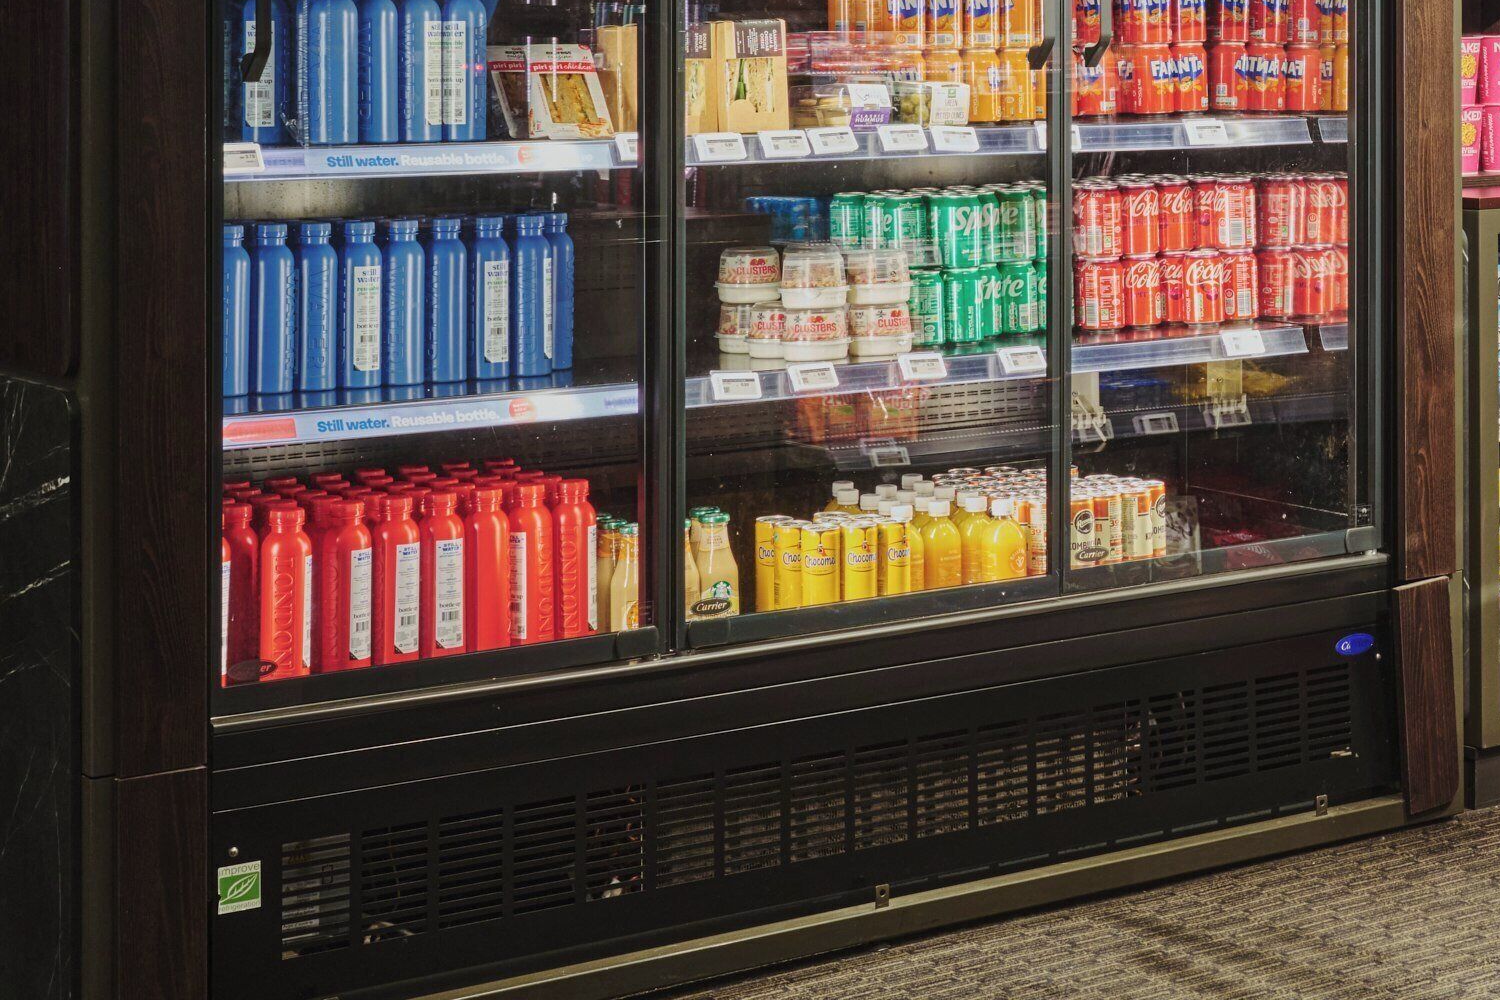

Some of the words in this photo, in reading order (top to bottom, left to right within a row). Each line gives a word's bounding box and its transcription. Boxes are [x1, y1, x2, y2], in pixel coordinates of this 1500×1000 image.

[327, 155, 353, 168] Still
[355, 155, 399, 167] water.
[402, 154, 462, 167] Reusable
[466, 152, 509, 166] bottle.
[736, 264, 776, 276] CLUSTERS
[794, 321, 837, 334] CLUSTERS
[317, 419, 343, 433] Still
[345, 417, 390, 431] water.
[391, 413, 454, 428] Reusable
[456, 409, 500, 425] bottle.
[758, 546, 775, 560] Choc
[783, 551, 801, 566] Choc
[847, 552, 877, 566] Chocom
[1078, 549, 1106, 560] Carrier
[274, 556, 295, 670] LONDON
[695, 600, 728, 613] Carrier
[219, 861, 261, 877] improve
